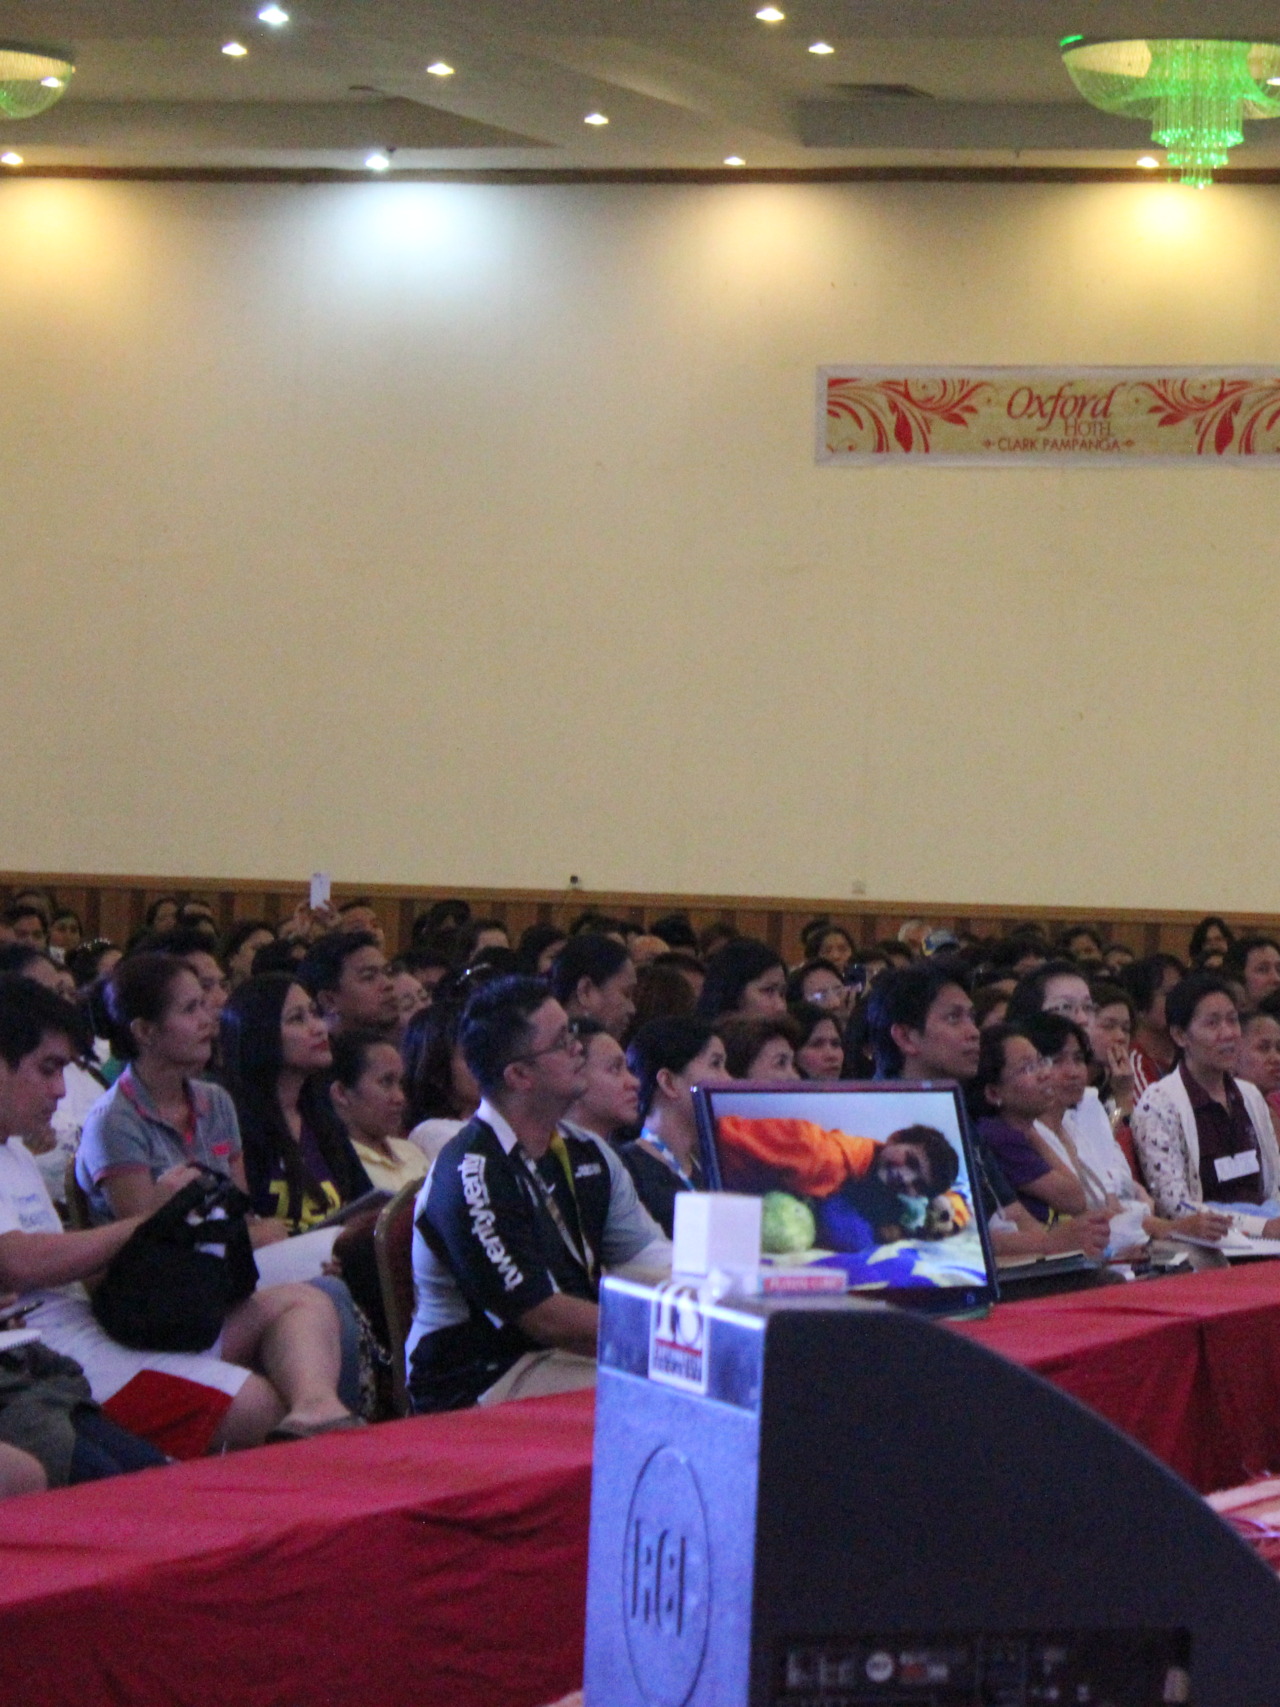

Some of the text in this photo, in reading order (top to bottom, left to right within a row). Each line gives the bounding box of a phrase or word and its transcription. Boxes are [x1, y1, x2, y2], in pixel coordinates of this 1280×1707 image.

[1006, 381, 1127, 432] Oxford
[1064, 418, 1115, 437] HOTEL
[997, 438, 1121, 451] CLARK PAMPANGA
